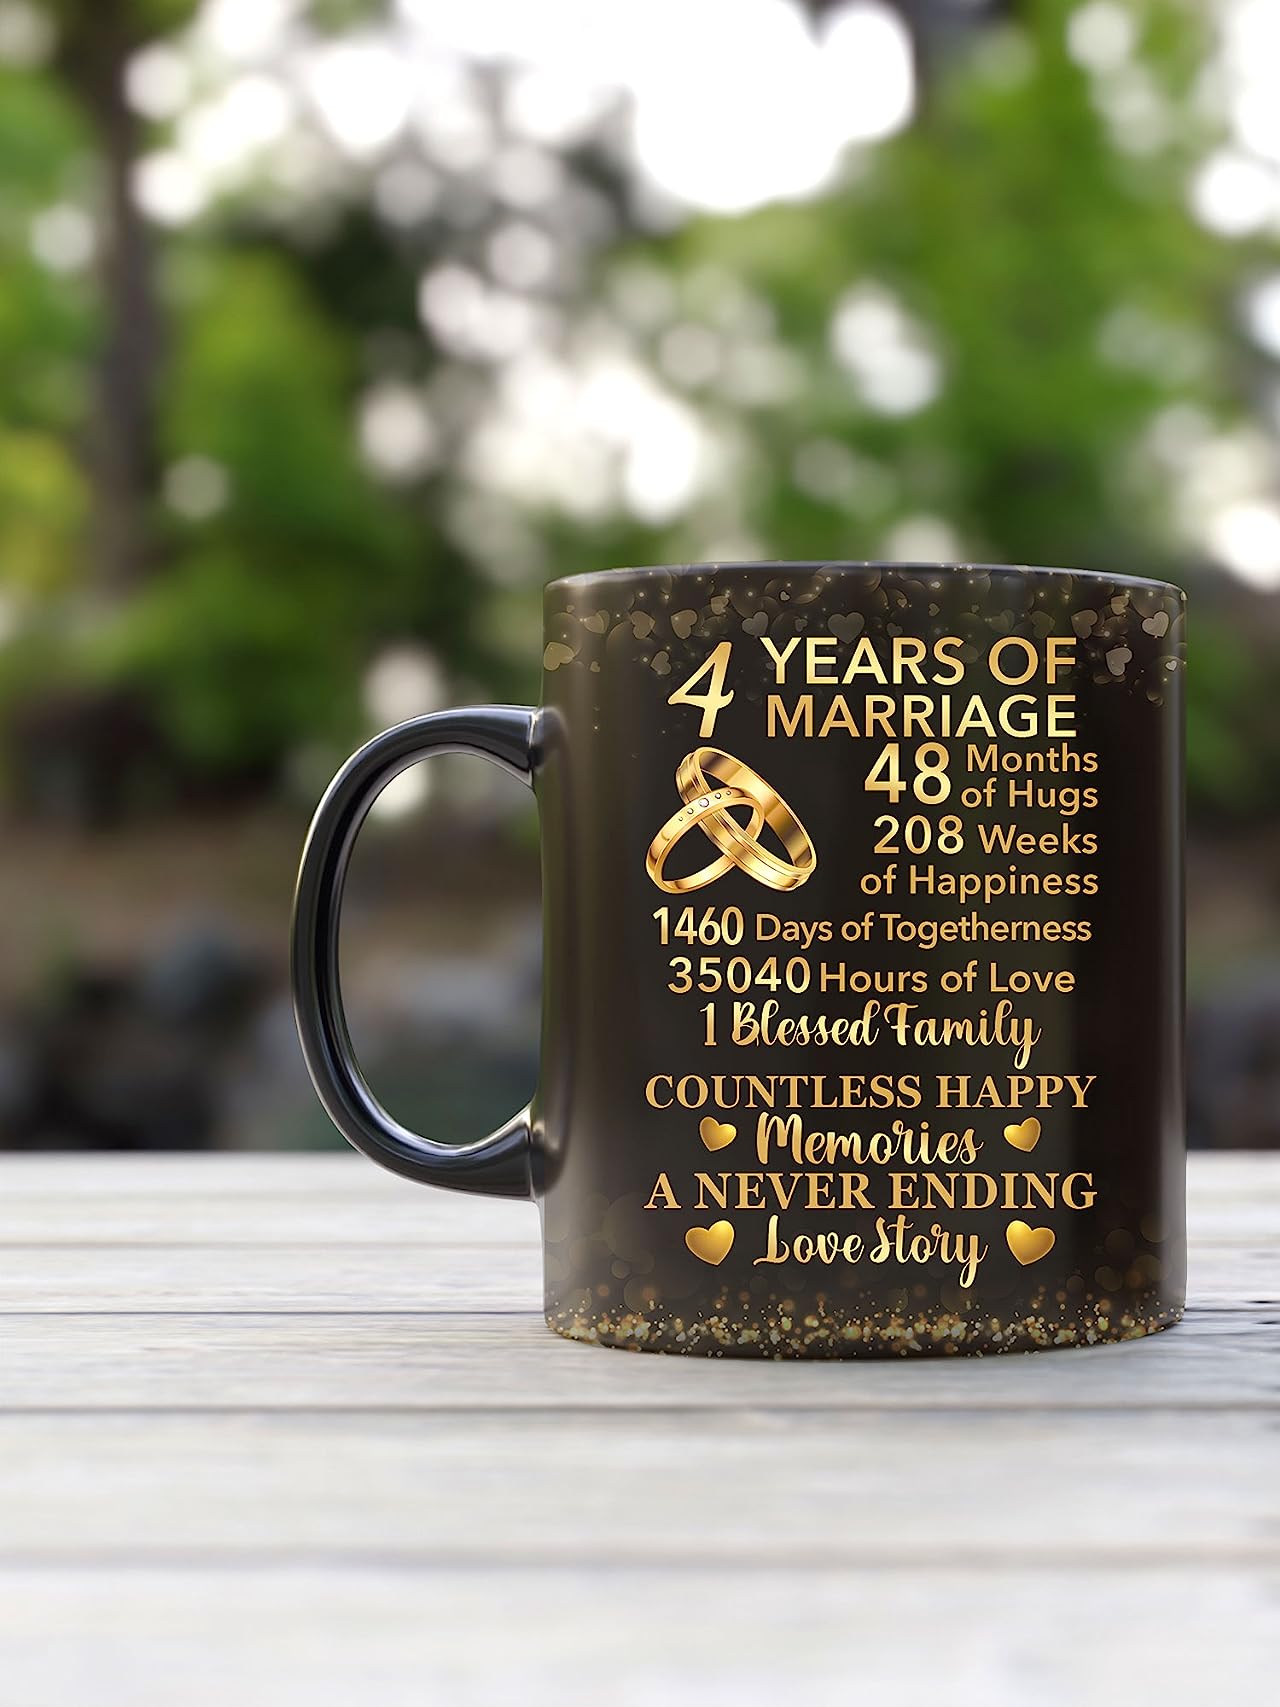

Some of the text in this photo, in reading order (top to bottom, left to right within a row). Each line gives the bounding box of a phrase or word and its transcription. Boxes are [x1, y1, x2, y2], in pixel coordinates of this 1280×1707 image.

[668, 637, 1076, 737] 4 YEARS OF
[768, 694, 1076, 738] MARRIAGE
[865, 743, 1098, 804] 48 Months
[961, 779, 1098, 815] of Hugs
[874, 814, 1098, 855] 208 Weeks
[861, 865, 1098, 903] of Happiness
[653, 907, 1092, 949] 1460 Days of Togetherness
[668, 956, 1076, 993] 35040 Hours of Love
[700, 999, 1041, 1070] 1 Blessed Family
[645, 1075, 1097, 1109] COUNTLESS HAPPY
[756, 1112, 984, 1165] Memories
[644, 1172, 1098, 1209] A NEVER ENDING
[753, 1214, 988, 1288] Love Story
